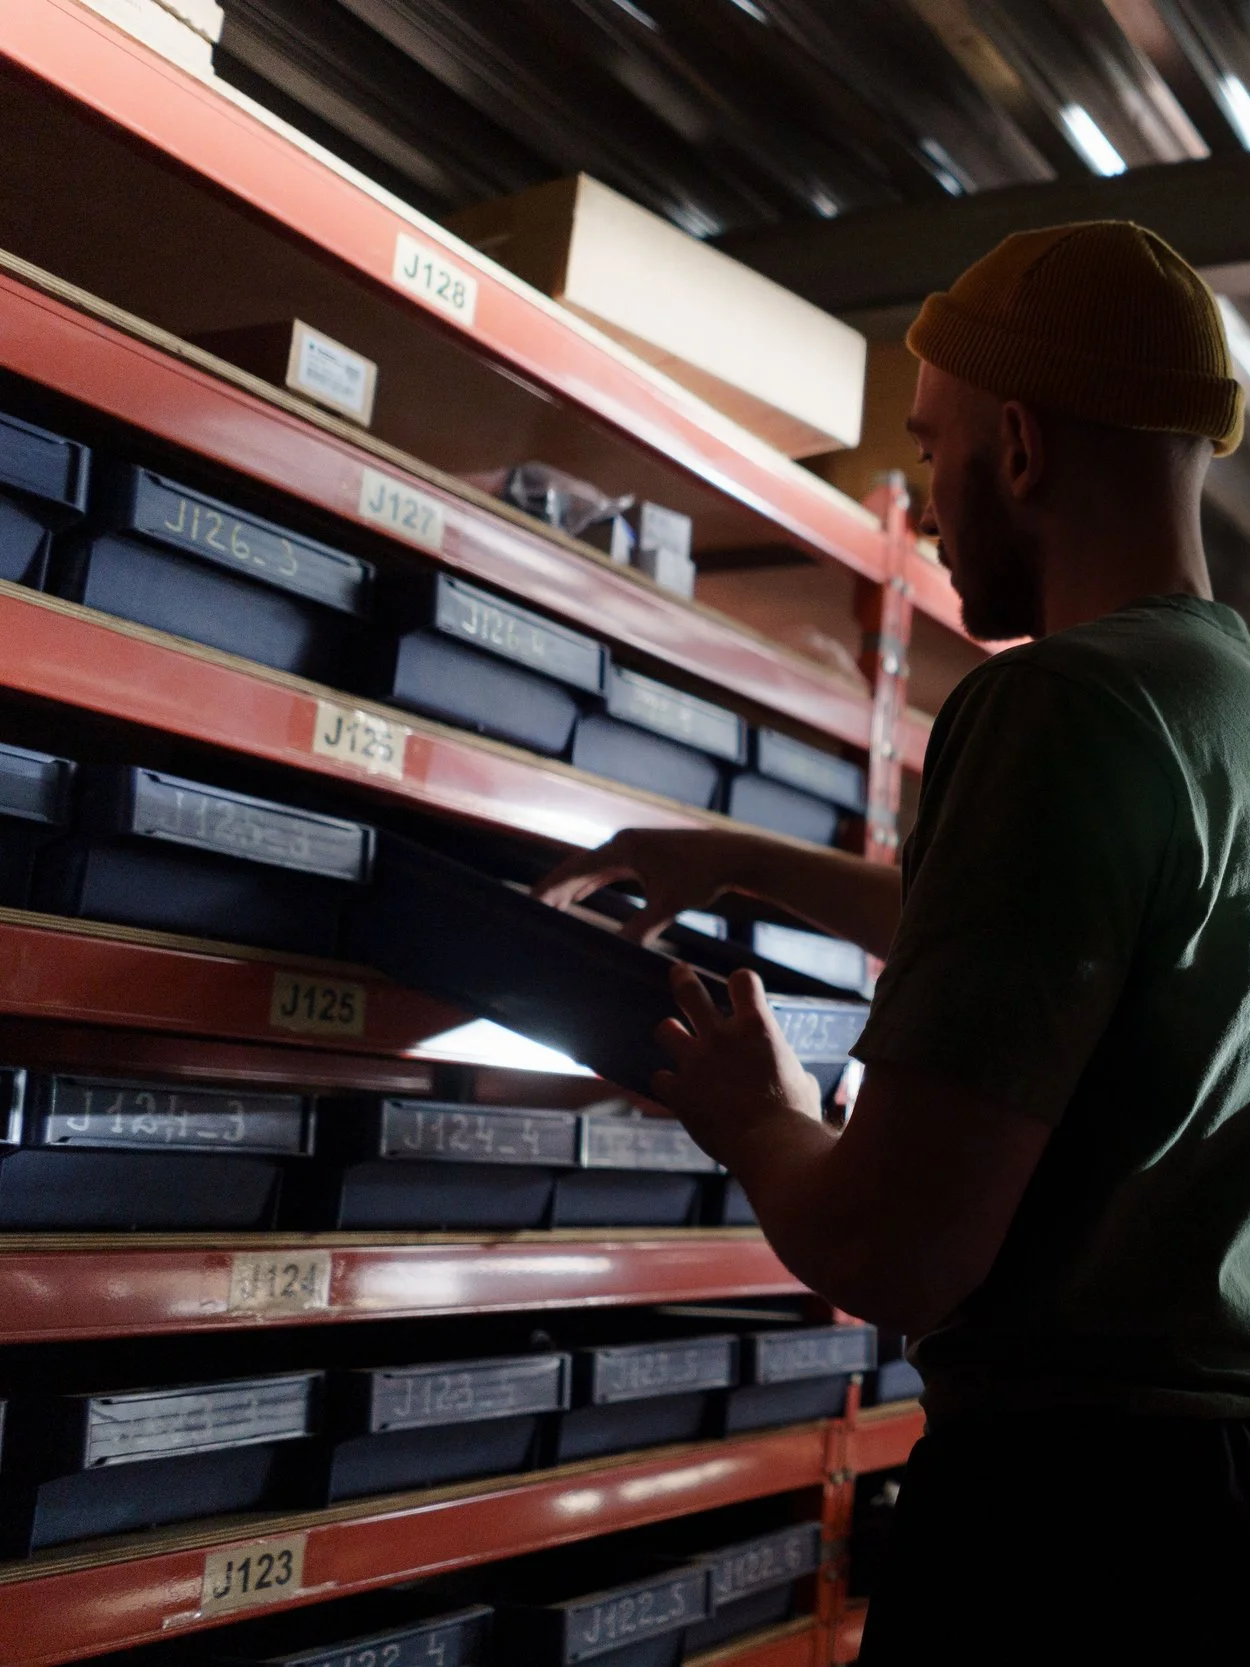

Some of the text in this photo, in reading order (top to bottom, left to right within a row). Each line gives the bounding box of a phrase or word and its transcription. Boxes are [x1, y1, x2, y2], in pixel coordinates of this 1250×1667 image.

[403, 254, 465, 309] J128
[369, 484, 437, 536] J127
[281, 984, 354, 1023] J125
[240, 1262, 316, 1298] J124
[213, 1549, 293, 1599] J123
